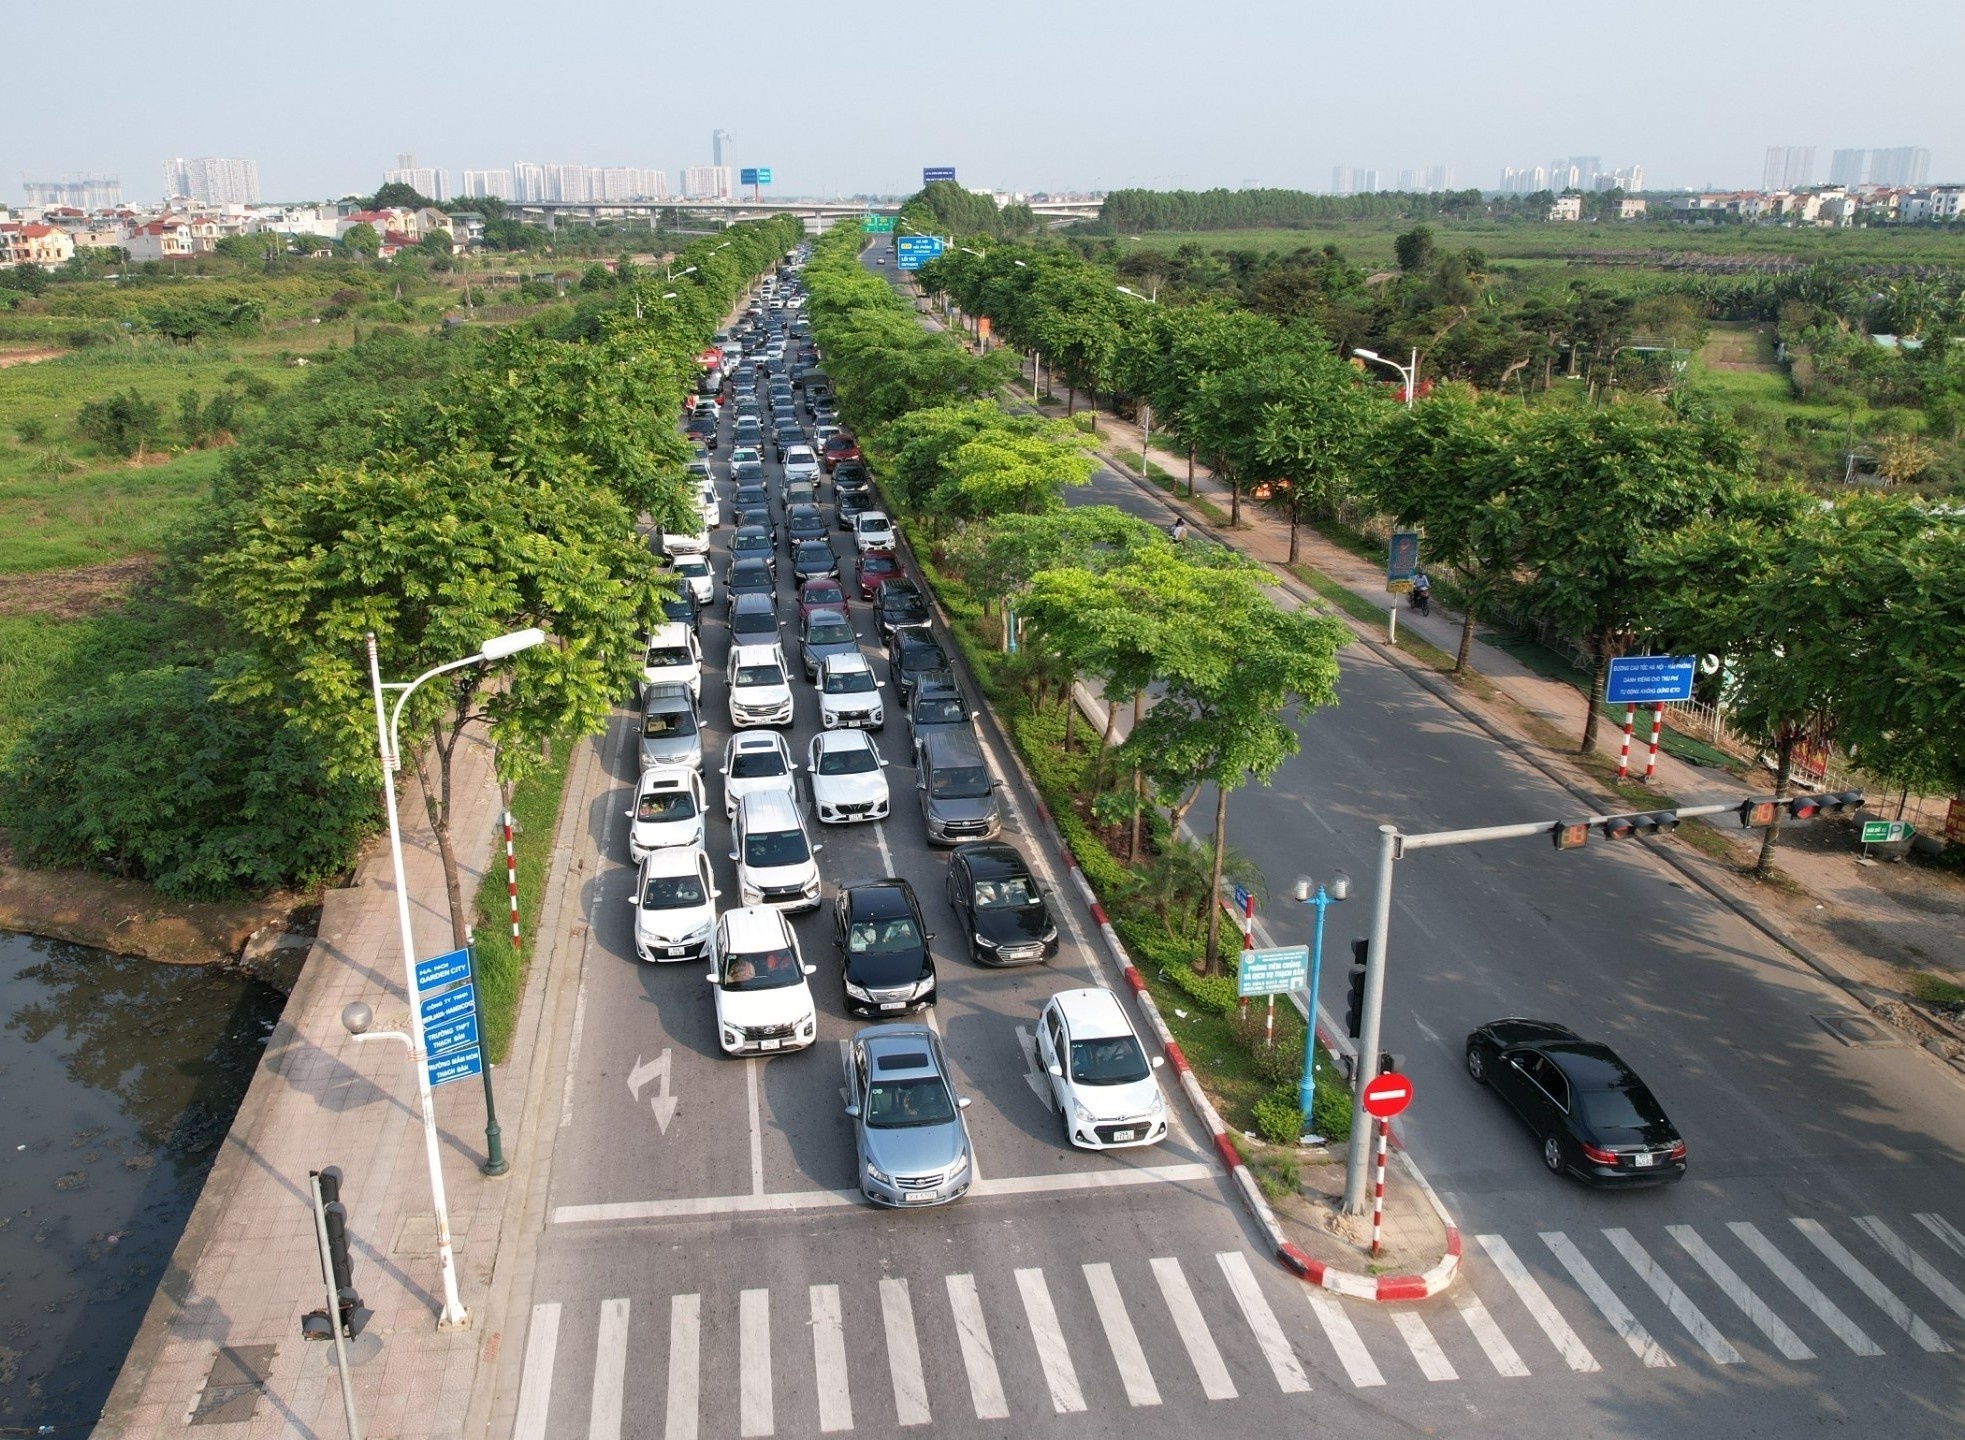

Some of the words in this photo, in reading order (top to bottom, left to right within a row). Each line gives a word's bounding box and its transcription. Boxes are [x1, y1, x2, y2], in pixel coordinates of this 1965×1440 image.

[420, 970, 450, 984] GARDEN
[450, 964, 466, 974] CITY
[426, 1001, 443, 1011] CÔNG
[428, 1027, 454, 1041] TRƯỜNG
[455, 1021, 470, 1031] THPT
[433, 1038, 452, 1048] THẠCH
[454, 1032, 466, 1042] BÀN
[466, 1052, 478, 1061] NON
[436, 1068, 455, 1078] THẠCH
[456, 1064, 469, 1073] BÀN
